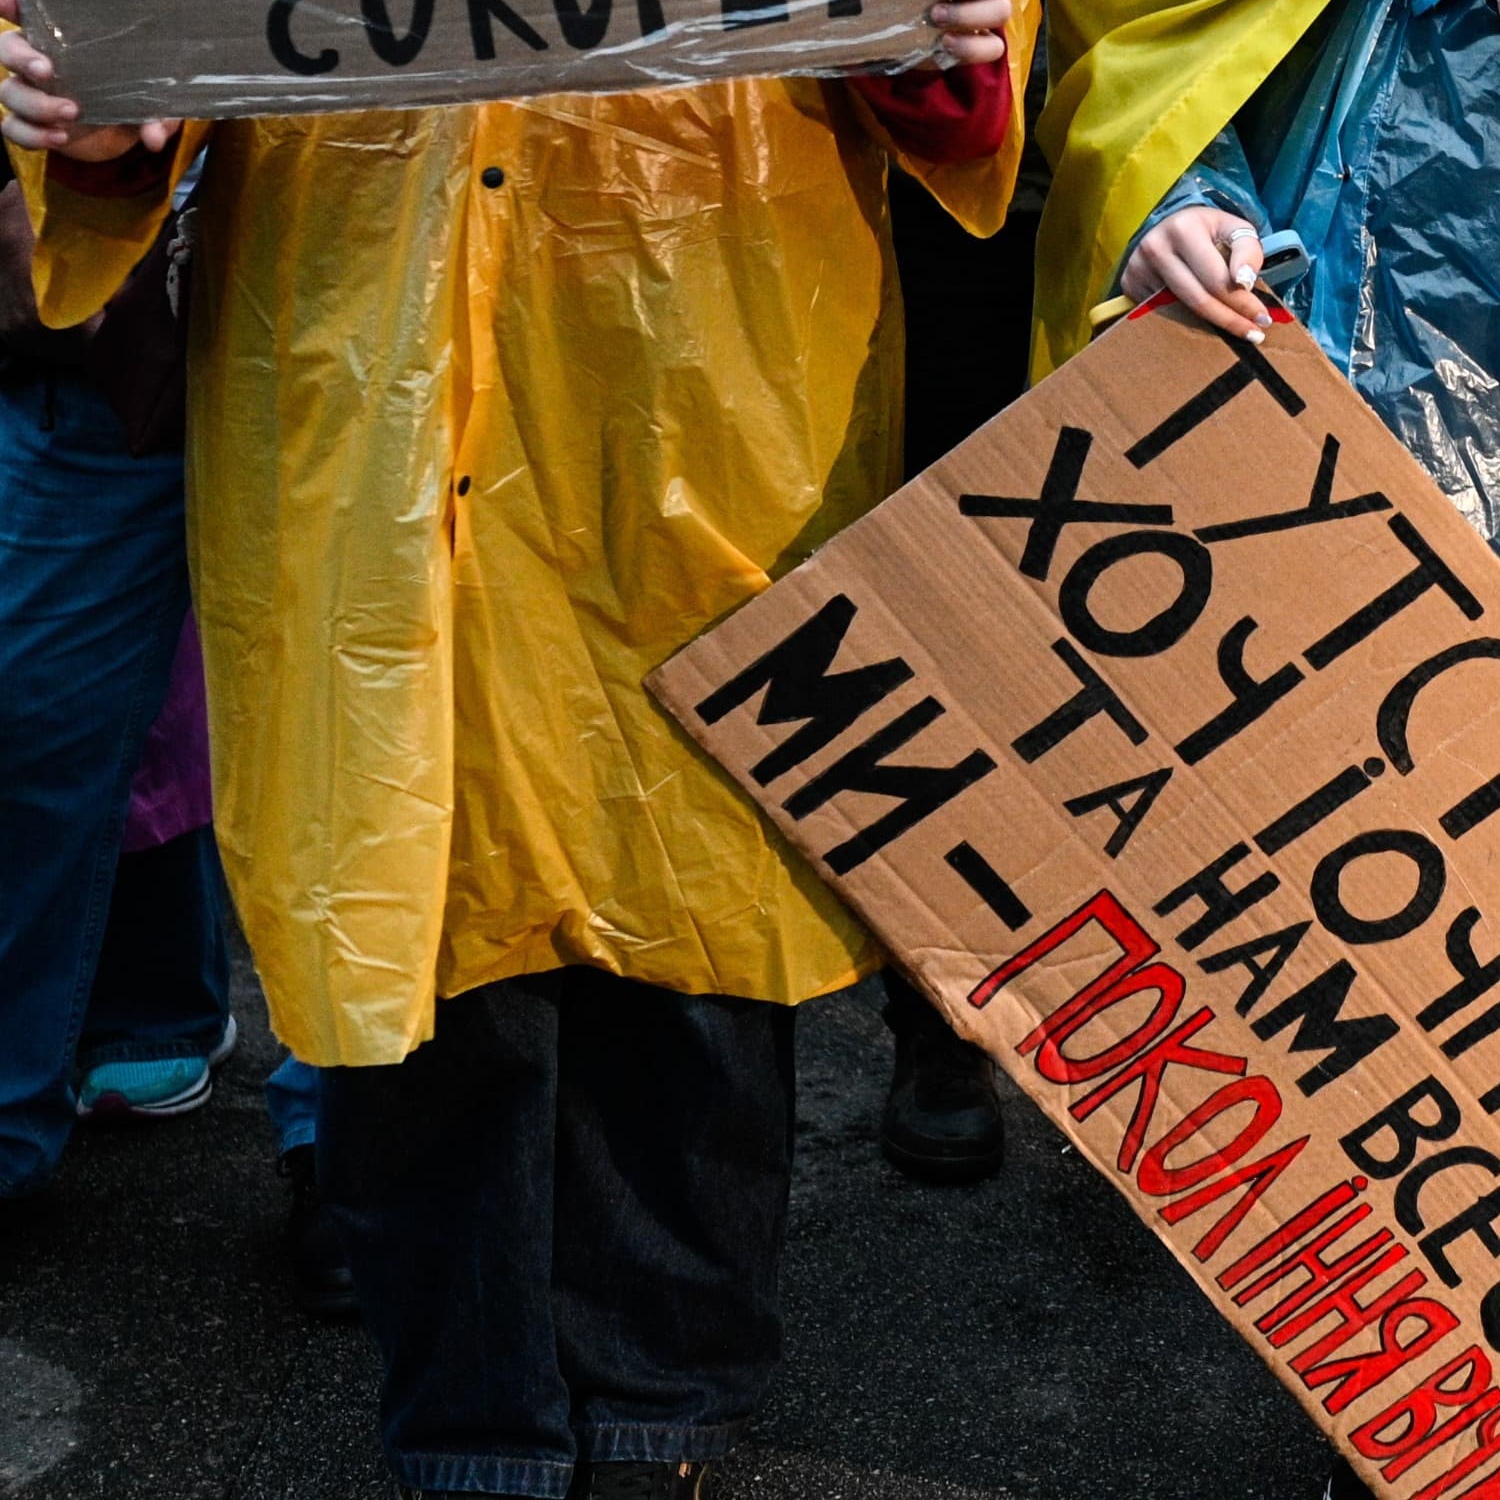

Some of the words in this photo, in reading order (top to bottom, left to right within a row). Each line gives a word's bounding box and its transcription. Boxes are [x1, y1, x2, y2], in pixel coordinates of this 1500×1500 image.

[1125, 336, 1483, 668] ТУТ
[1013, 638, 1175, 859] ТА
[1154, 840, 1400, 1095] НАМ
[969, 888, 1461, 1423] ПОКОЛІННЯ
